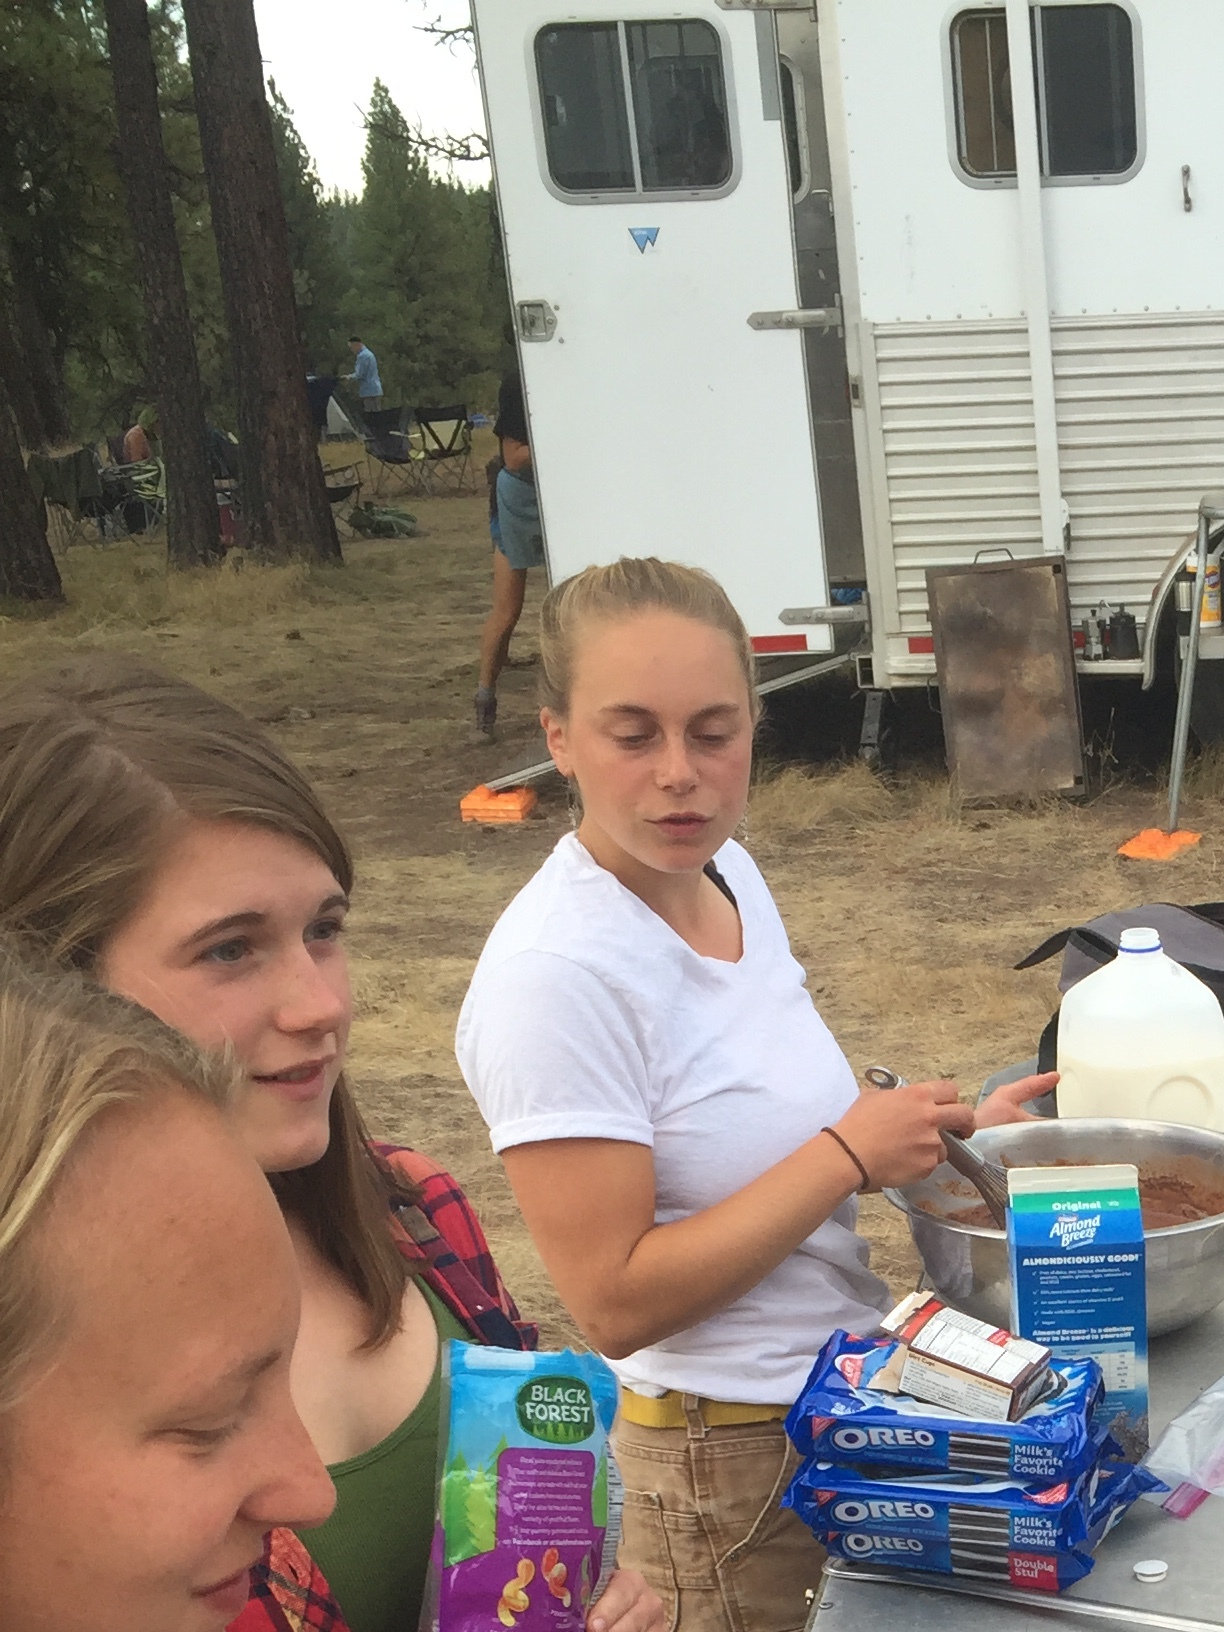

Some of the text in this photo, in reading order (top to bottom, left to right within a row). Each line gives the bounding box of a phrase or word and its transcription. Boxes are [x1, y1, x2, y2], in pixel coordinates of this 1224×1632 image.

[1052, 1201, 1101, 1212] Original
[1049, 1215, 1101, 1238] Almond
[1061, 1227, 1097, 1247] Breeze
[1022, 1254, 1138, 1266] ALMONDICIOUSLY GOOD!
[531, 1385, 586, 1404] BLACK
[525, 1401, 590, 1423] FOREST
[834, 1428, 935, 1449] OREO
[1014, 1444, 1052, 1456] Milk's
[1013, 1464, 1055, 1475] Cookie
[834, 1501, 935, 1522] OREO
[1014, 1517, 1052, 1528] Milk's
[846, 1533, 923, 1552] OREO
[1013, 1535, 1056, 1547] Cookie
[1013, 1558, 1055, 1572] Double
